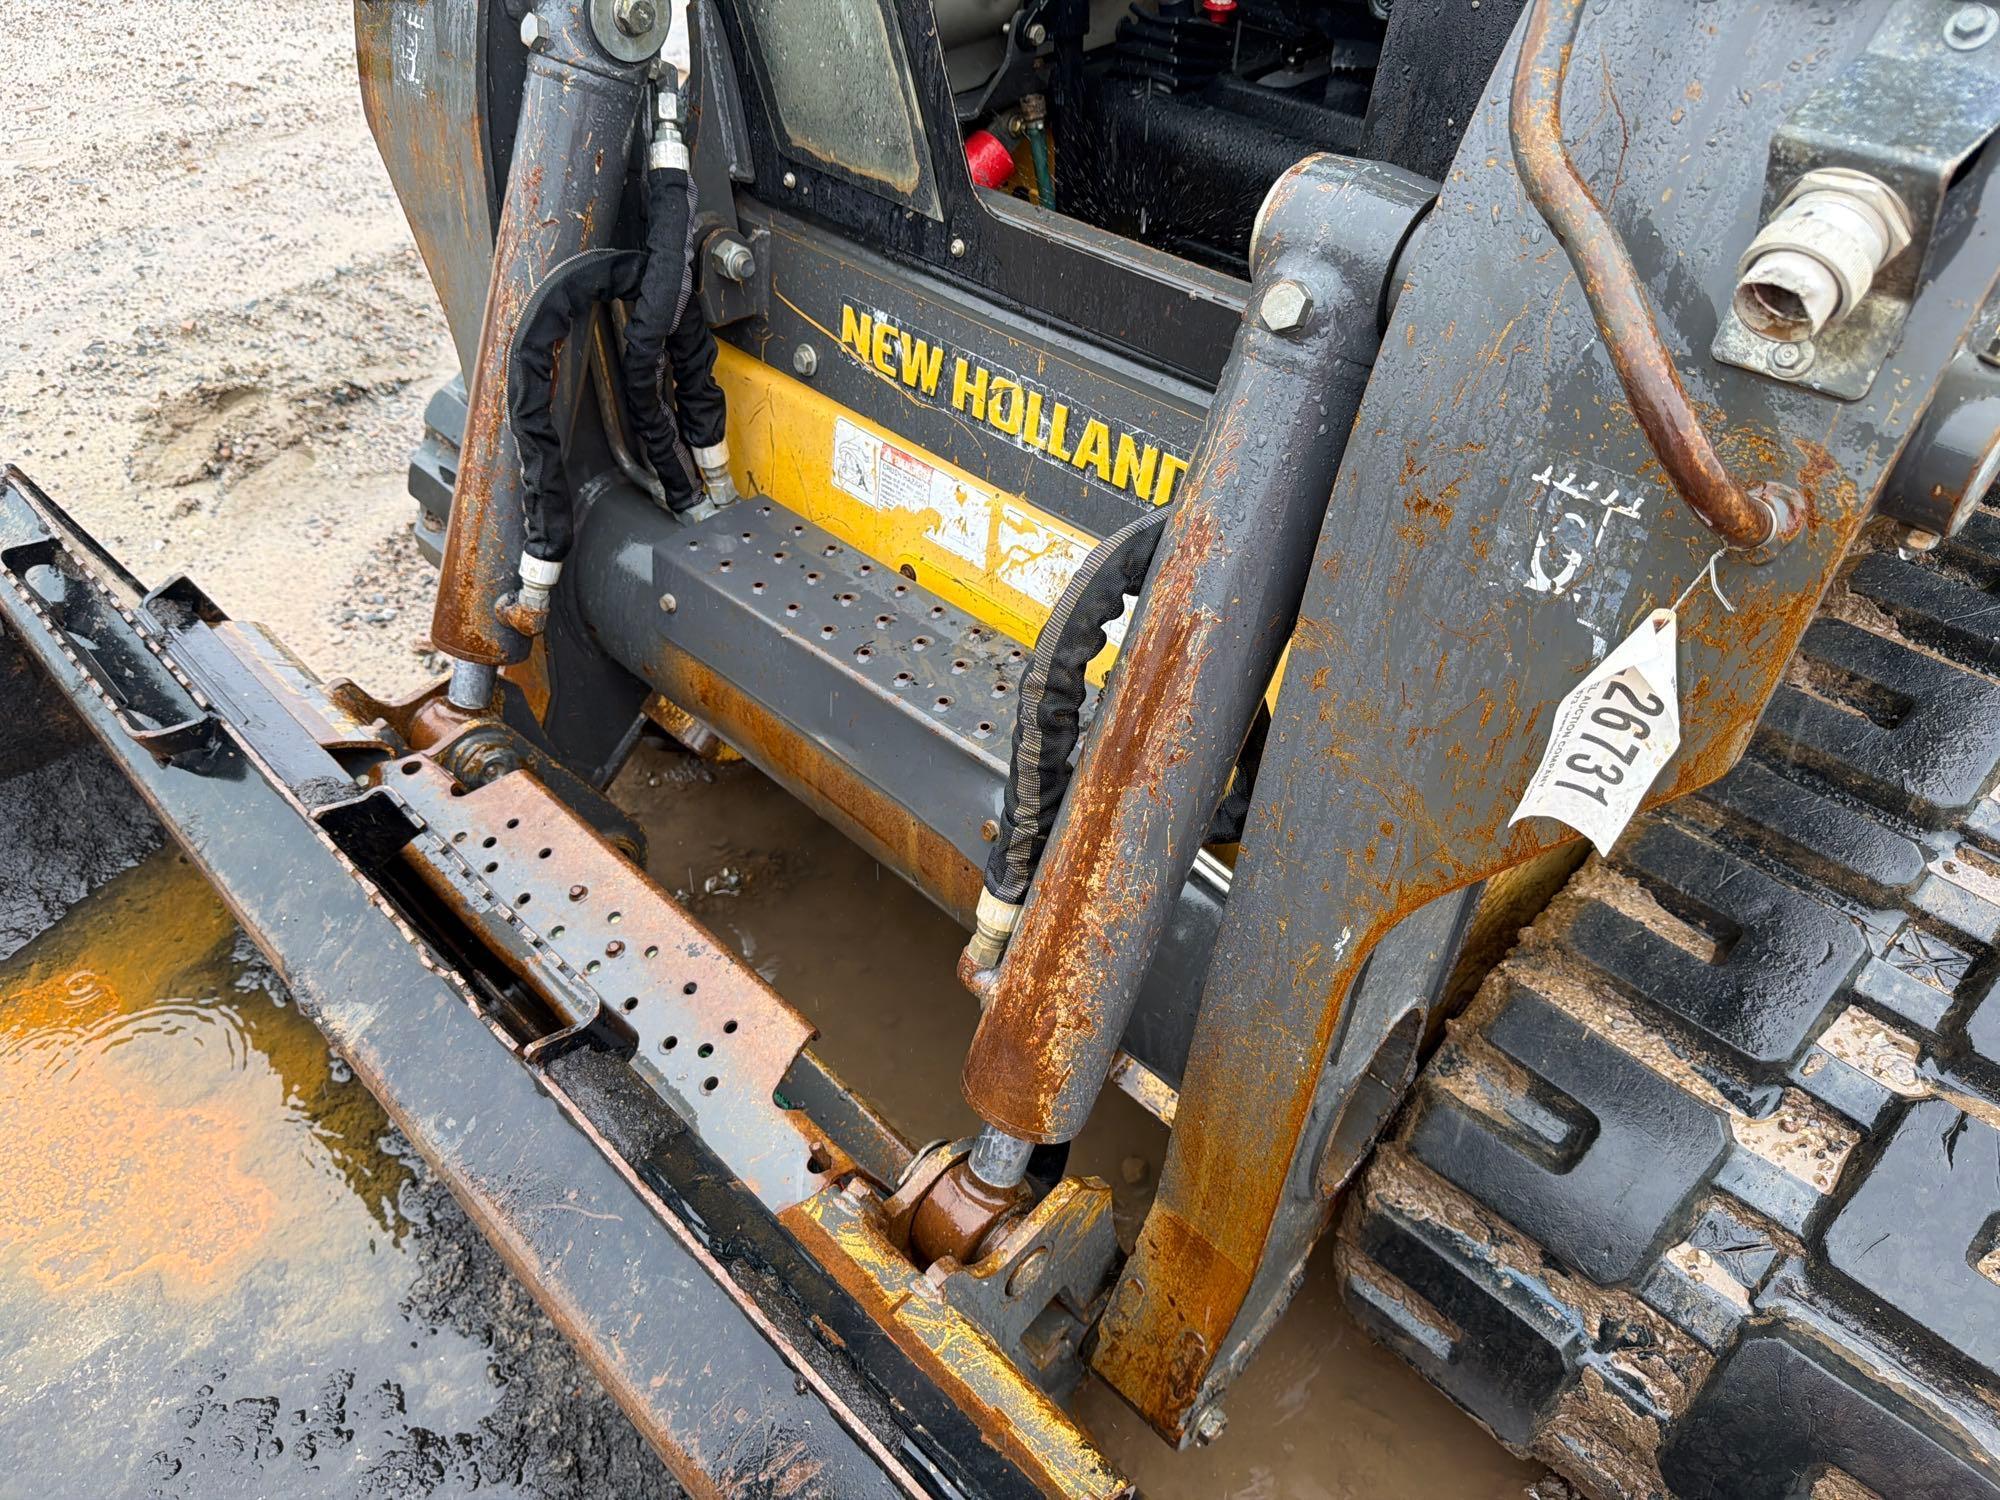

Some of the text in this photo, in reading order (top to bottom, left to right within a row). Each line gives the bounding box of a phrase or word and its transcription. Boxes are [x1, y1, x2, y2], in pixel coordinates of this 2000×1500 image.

[842, 304, 944, 397] NEW
[1554, 680, 1665, 807] 26731
[1562, 695, 1592, 738] AUCTION
[1538, 740, 1566, 787] COMPANY
